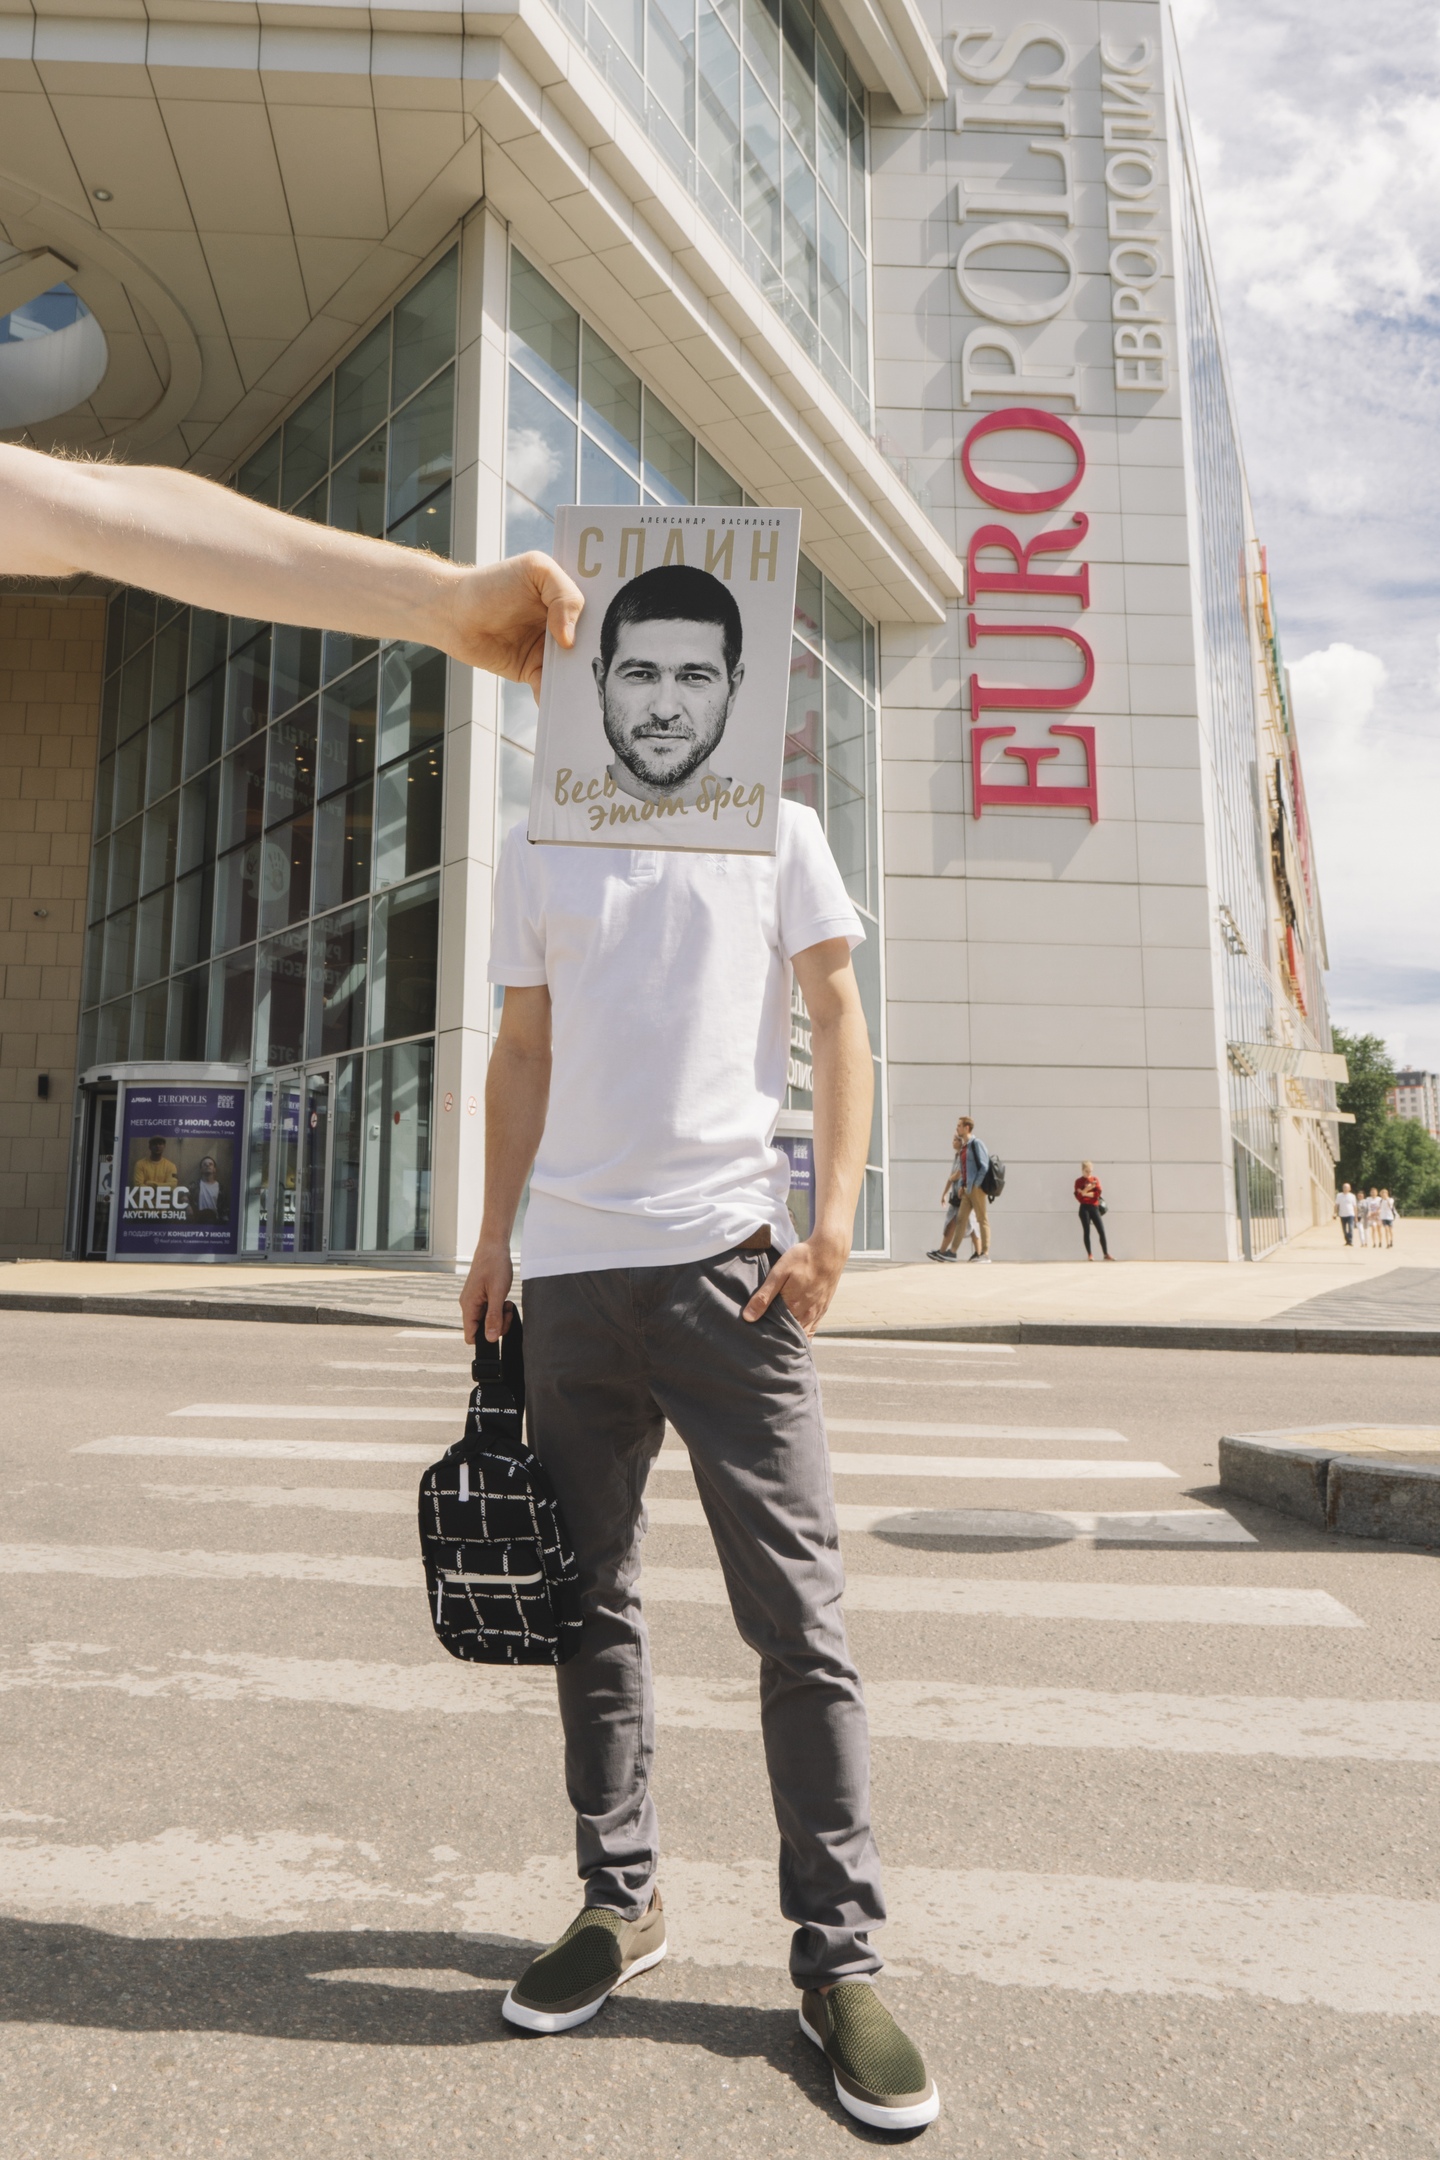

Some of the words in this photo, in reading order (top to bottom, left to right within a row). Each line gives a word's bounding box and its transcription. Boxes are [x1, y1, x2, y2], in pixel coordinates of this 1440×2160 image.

[1100, 33, 1169, 391] ЕВРОПОЛИС
[949, 22, 1099, 825] EUROPOLIS
[639, 516, 707, 525] АЛЕКСАНДР
[721, 517, 782, 527] ВАСИЛЬЕВ
[553, 767, 617, 806] Весь
[587, 796, 688, 832] этот
[696, 775, 766, 829] бред
[158, 1095, 207, 1104] EUROPOLIS
[130, 1118, 177, 1127] MEET&GREET
[213, 1119, 236, 1128] 20:00
[790, 1170, 810, 1178] 20:00
[124, 1186, 190, 1209] KREC
[123, 1211, 160, 1219] АКУСТИК
[161, 1211, 187, 1220] БЭНД
